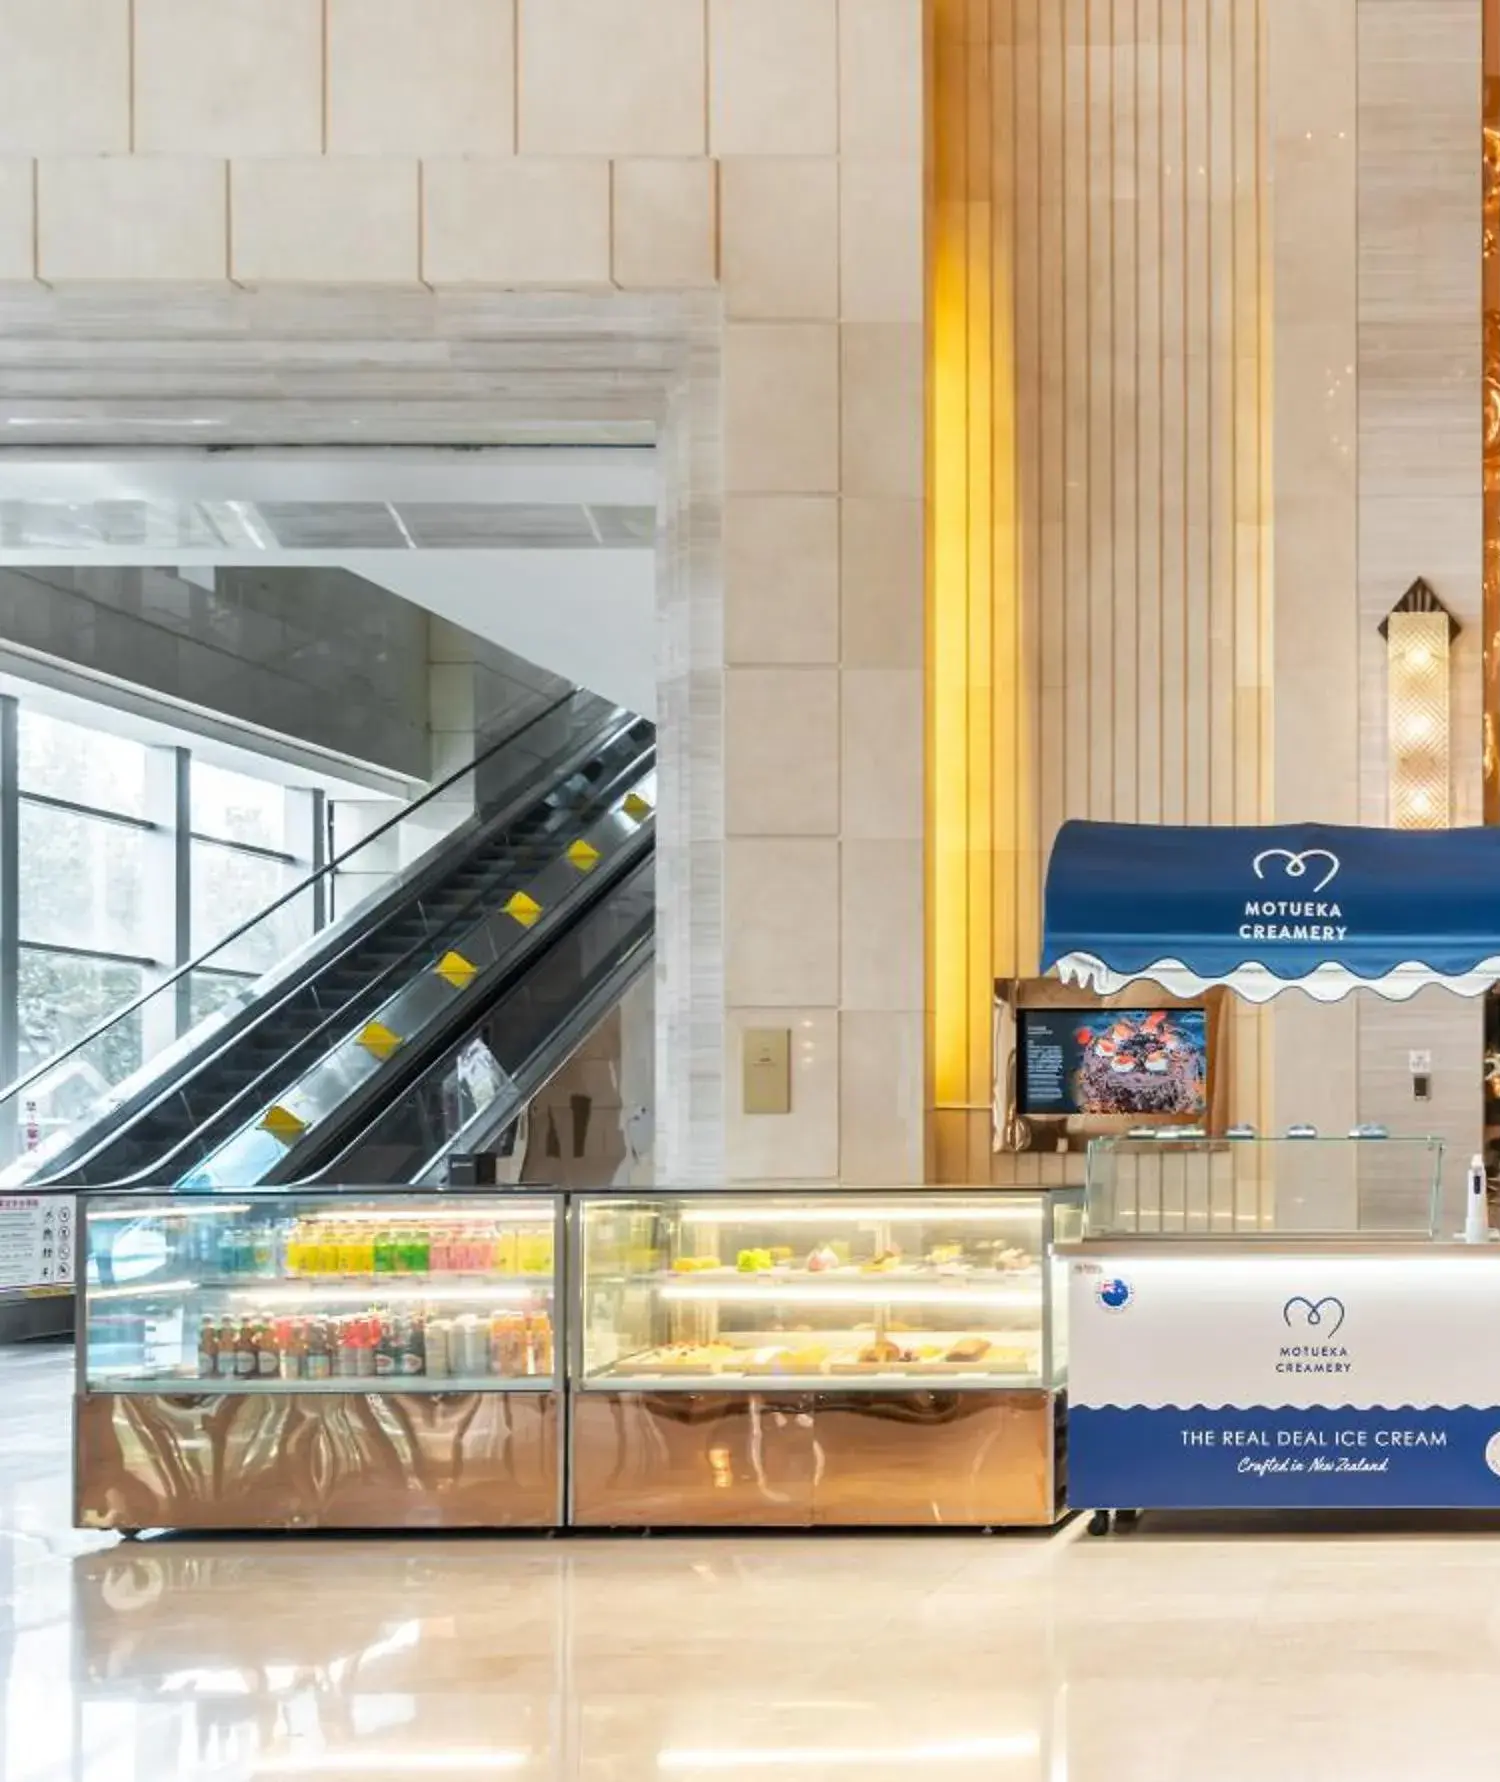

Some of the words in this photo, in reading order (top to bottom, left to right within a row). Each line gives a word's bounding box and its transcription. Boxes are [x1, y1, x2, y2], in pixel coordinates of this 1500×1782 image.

[1244, 901, 1342, 917] MOTUEKA
[1239, 924, 1347, 940] CREAMERY
[1280, 1346, 1347, 1357] MOTUEKA
[1275, 1362, 1351, 1373] CREAMERY
[1180, 1430, 1215, 1446] THE
[1222, 1430, 1270, 1446] REAL
[1277, 1430, 1328, 1446] DEAL
[1335, 1430, 1367, 1446] ICE
[1375, 1430, 1448, 1446] CREAM
[1237, 1456, 1289, 1476] Crafted
[1290, 1458, 1304, 1472] in
[1308, 1456, 1334, 1473] New
[1334, 1457, 1389, 1473] Zealand
